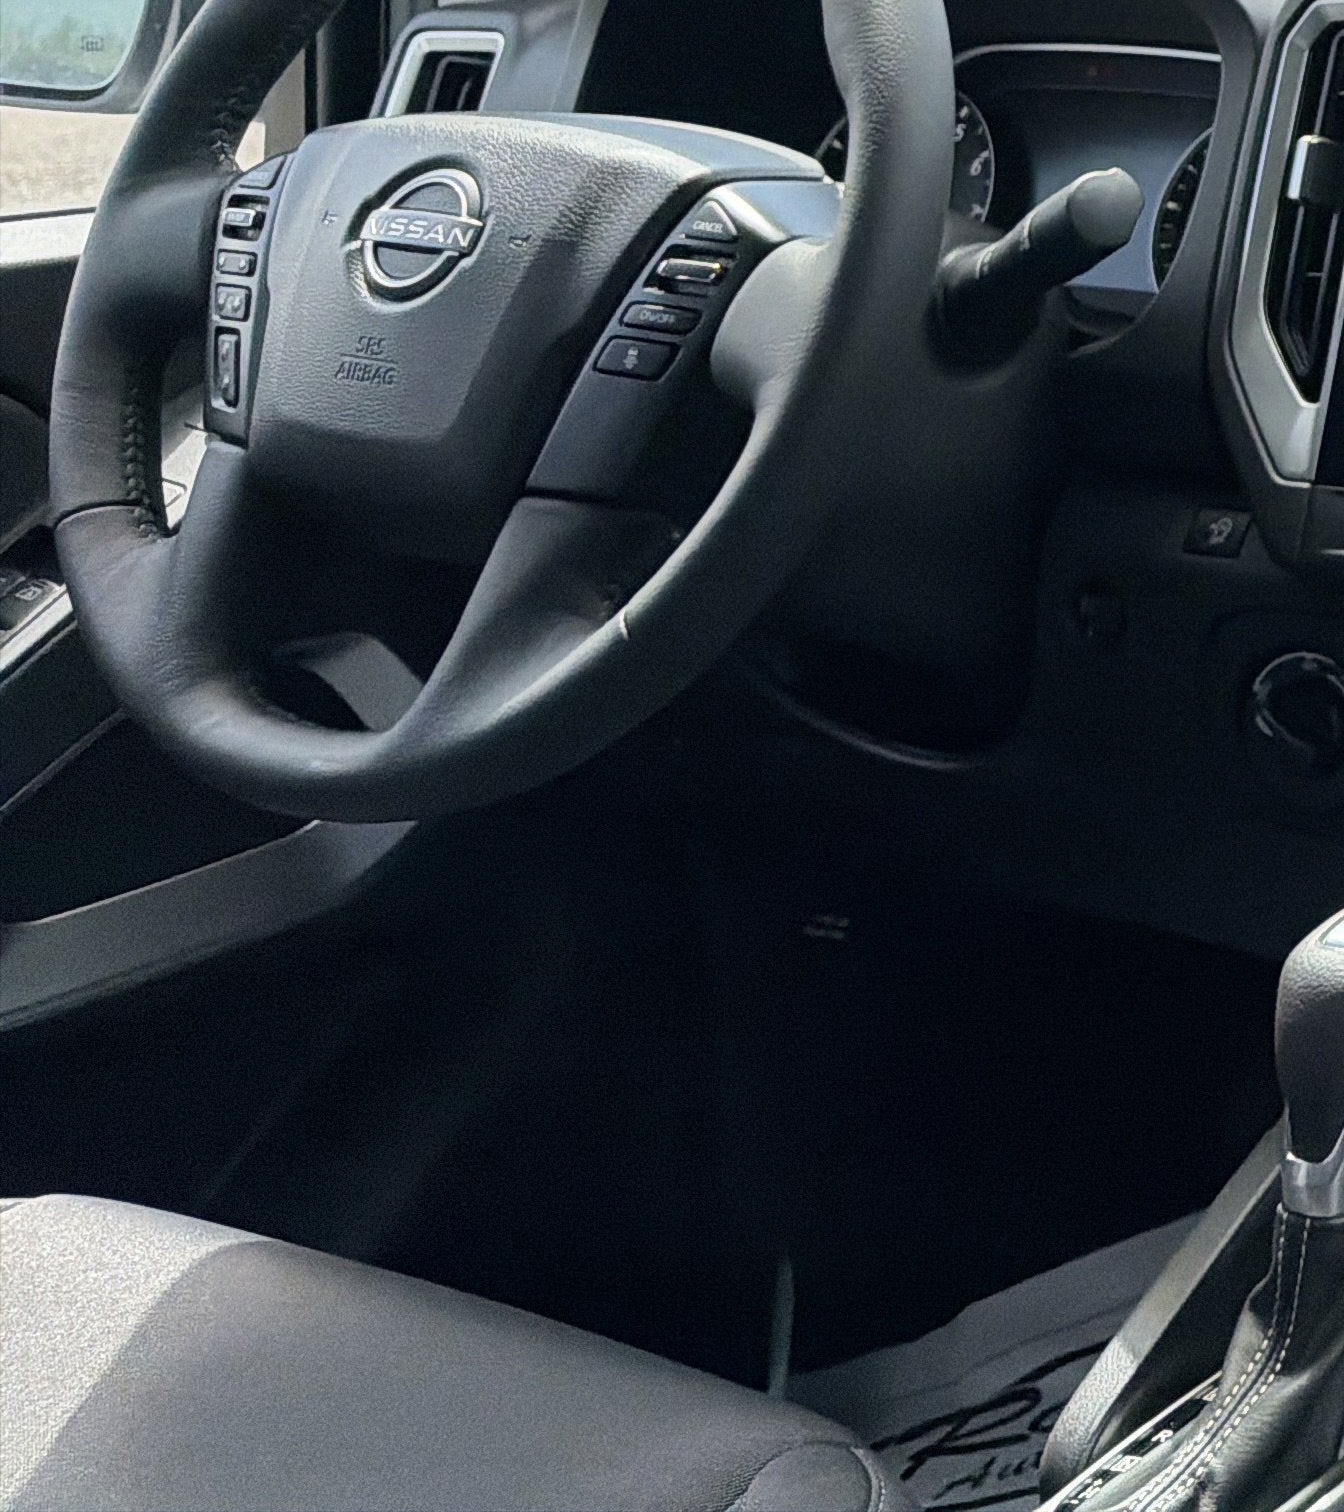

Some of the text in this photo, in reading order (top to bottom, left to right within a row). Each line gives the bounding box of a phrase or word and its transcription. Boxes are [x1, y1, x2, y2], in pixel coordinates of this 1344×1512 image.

[970, 149, 990, 177] 6
[369, 216, 477, 248] NISSAN
[692, 220, 724, 234] CANCEL
[354, 334, 386, 356] SRS
[334, 360, 397, 386] AIRBAG
